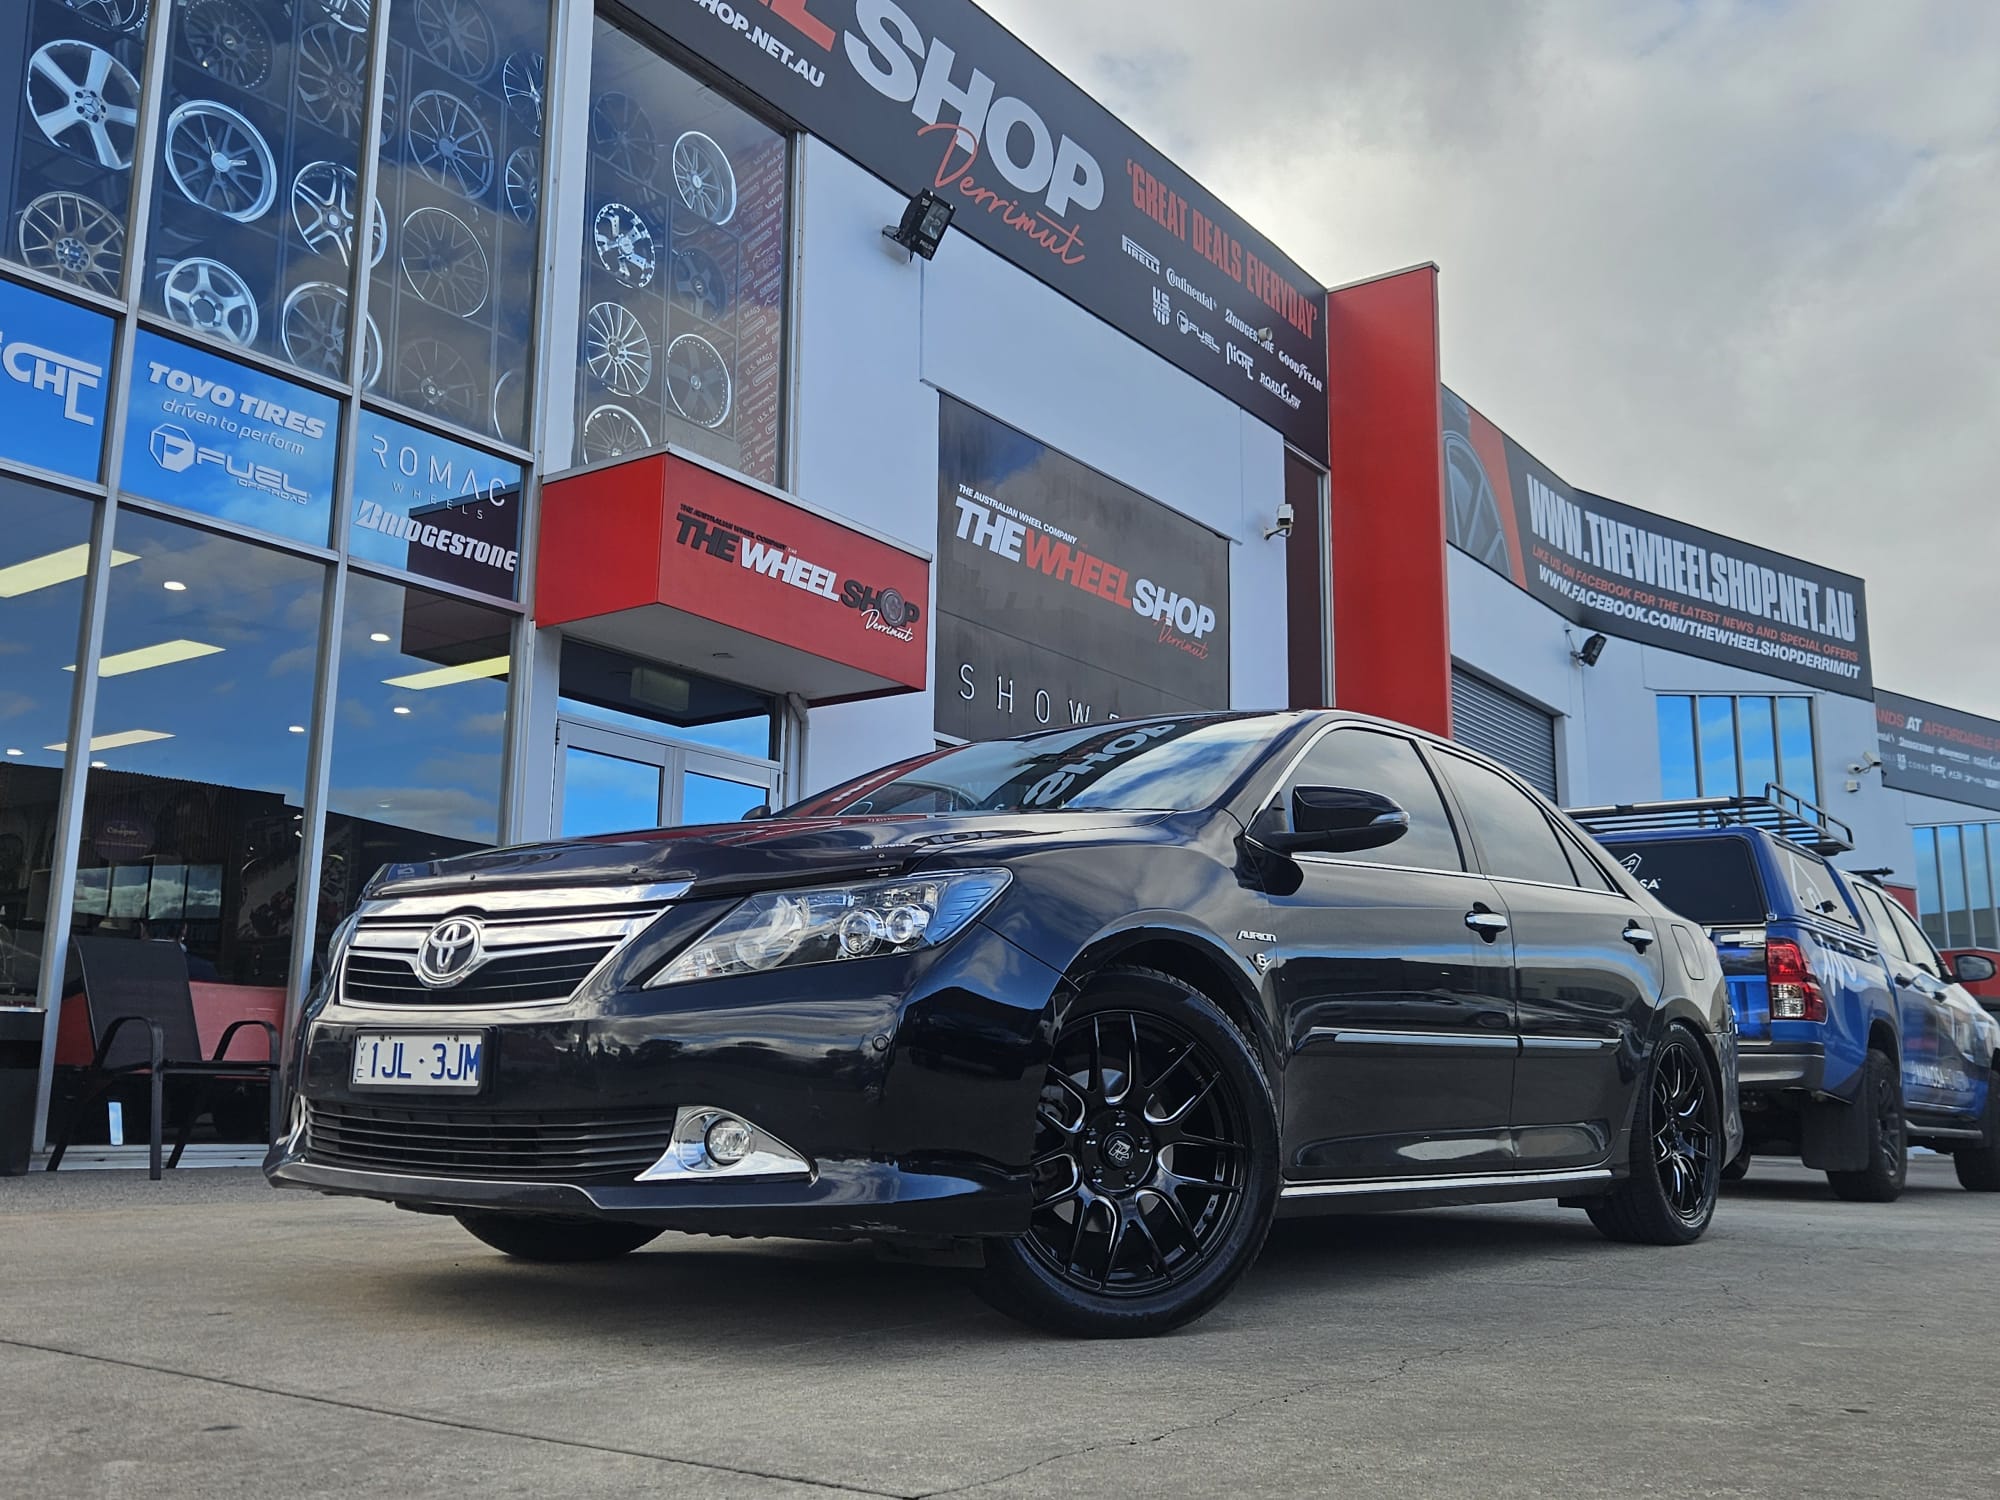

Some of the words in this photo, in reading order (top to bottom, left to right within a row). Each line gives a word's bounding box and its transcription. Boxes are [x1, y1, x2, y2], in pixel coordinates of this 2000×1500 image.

[843, 0, 1104, 217] SHOP
[917, 123, 1085, 264] Derrimut
[1121, 234, 1160, 275] PIRELLI
[1193, 208, 1242, 283] DEALS
[1166, 267, 1216, 311] Continental
[1188, 320, 1221, 352] FUEL
[149, 361, 235, 408] TOYO
[239, 393, 326, 439] TIRES
[1278, 350, 1322, 392] GOODYEAR
[162, 399, 217, 427] driven
[220, 416, 238, 433] to
[238, 426, 304, 455] perform
[196, 447, 308, 498] FUEL
[371, 434, 506, 506] ROMAC
[392, 481, 484, 520] WHEELS
[354, 499, 519, 572] BRIDGESTONE
[958, 484, 973, 497] THE
[973, 491, 1018, 518] AUSTRALIAN
[1019, 511, 1043, 530] WHEEL
[1043, 523, 1078, 545] COMPANY
[676, 512, 740, 563] THE
[741, 537, 840, 602] WHEEL
[955, 496, 1026, 563] THE
[1025, 527, 1132, 609] WHEEL
[1132, 578, 1216, 638] SHOP
[1526, 473, 1856, 643] WWW.THEWHEELSHOP.NET.AU
[861, 609, 914, 642] Derrimut
[1532, 543, 1549, 563] LIKE
[1550, 554, 1562, 570] US
[1562, 563, 1575, 579] ON
[1575, 569, 1633, 599] FACEBOOK
[1633, 590, 1656, 606] FOR
[1657, 597, 1679, 613] THE
[1680, 604, 1721, 624] LATEST
[1722, 614, 1754, 634] NEWS
[1755, 625, 1777, 640] AND
[1780, 631, 1821, 653] SPECIAL
[1823, 643, 1858, 662] OFFERS
[1539, 564, 1861, 680] WWW.FACEBOOK.COM/THEWHEELSHOPDERRIMUT
[1153, 616, 1208, 660] Derrimut
[959, 663, 1120, 724] SHOW
[1905, 716, 1922, 732] AT
